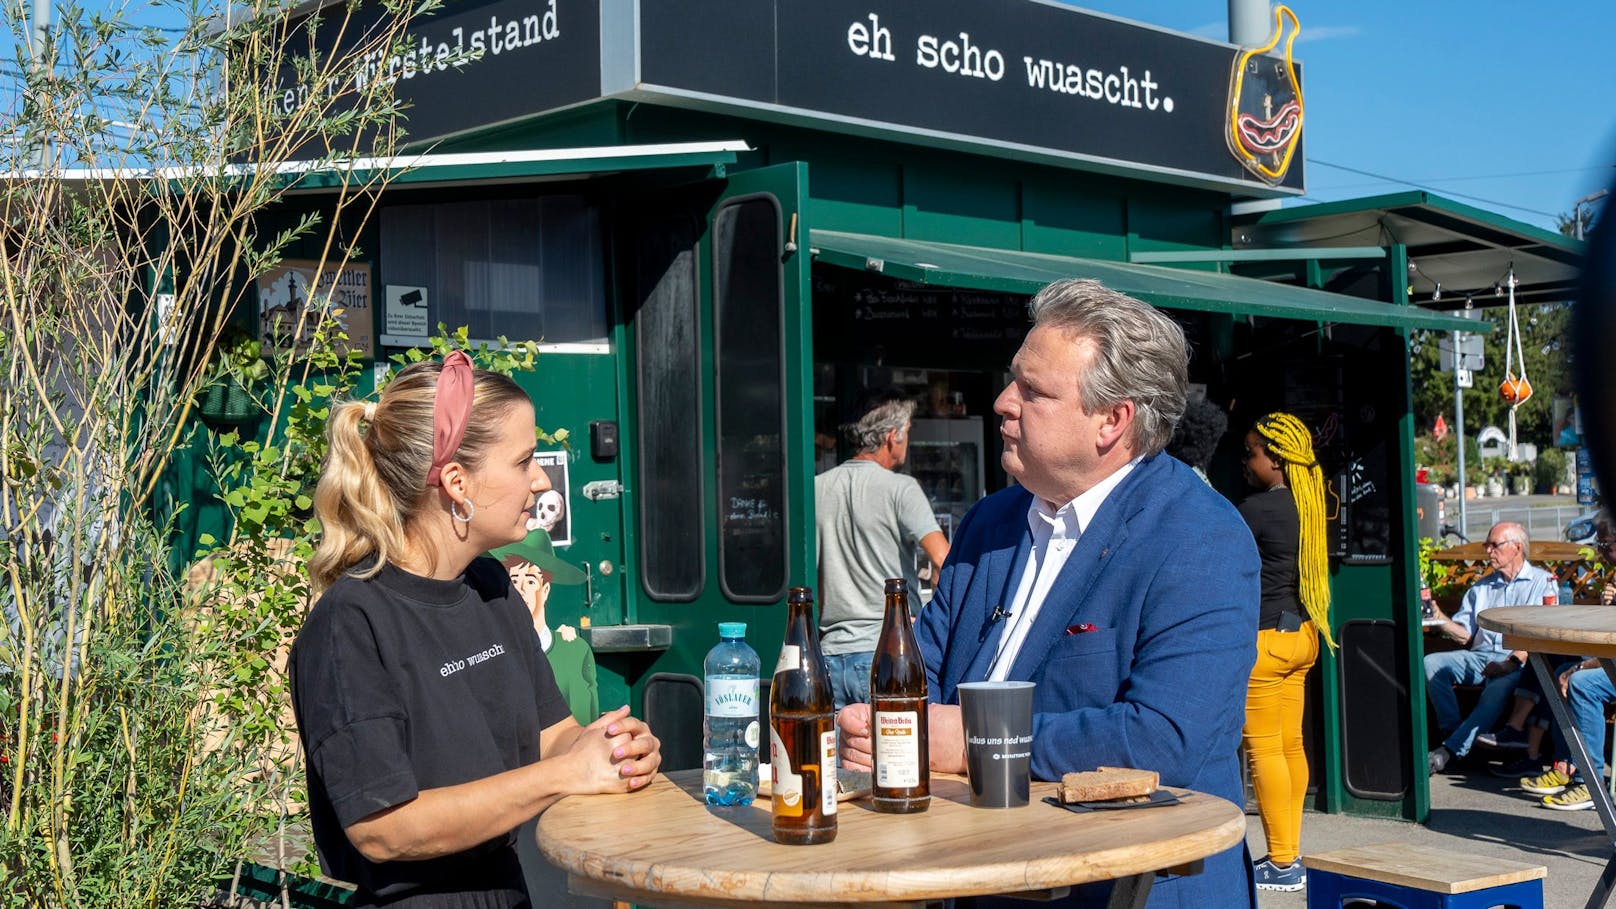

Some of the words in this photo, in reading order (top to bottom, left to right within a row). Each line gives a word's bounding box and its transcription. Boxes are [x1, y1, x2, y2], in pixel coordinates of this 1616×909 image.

[847, 12, 896, 61] eh
[916, 32, 1005, 82] scho
[1023, 55, 1175, 113] wuascht.
